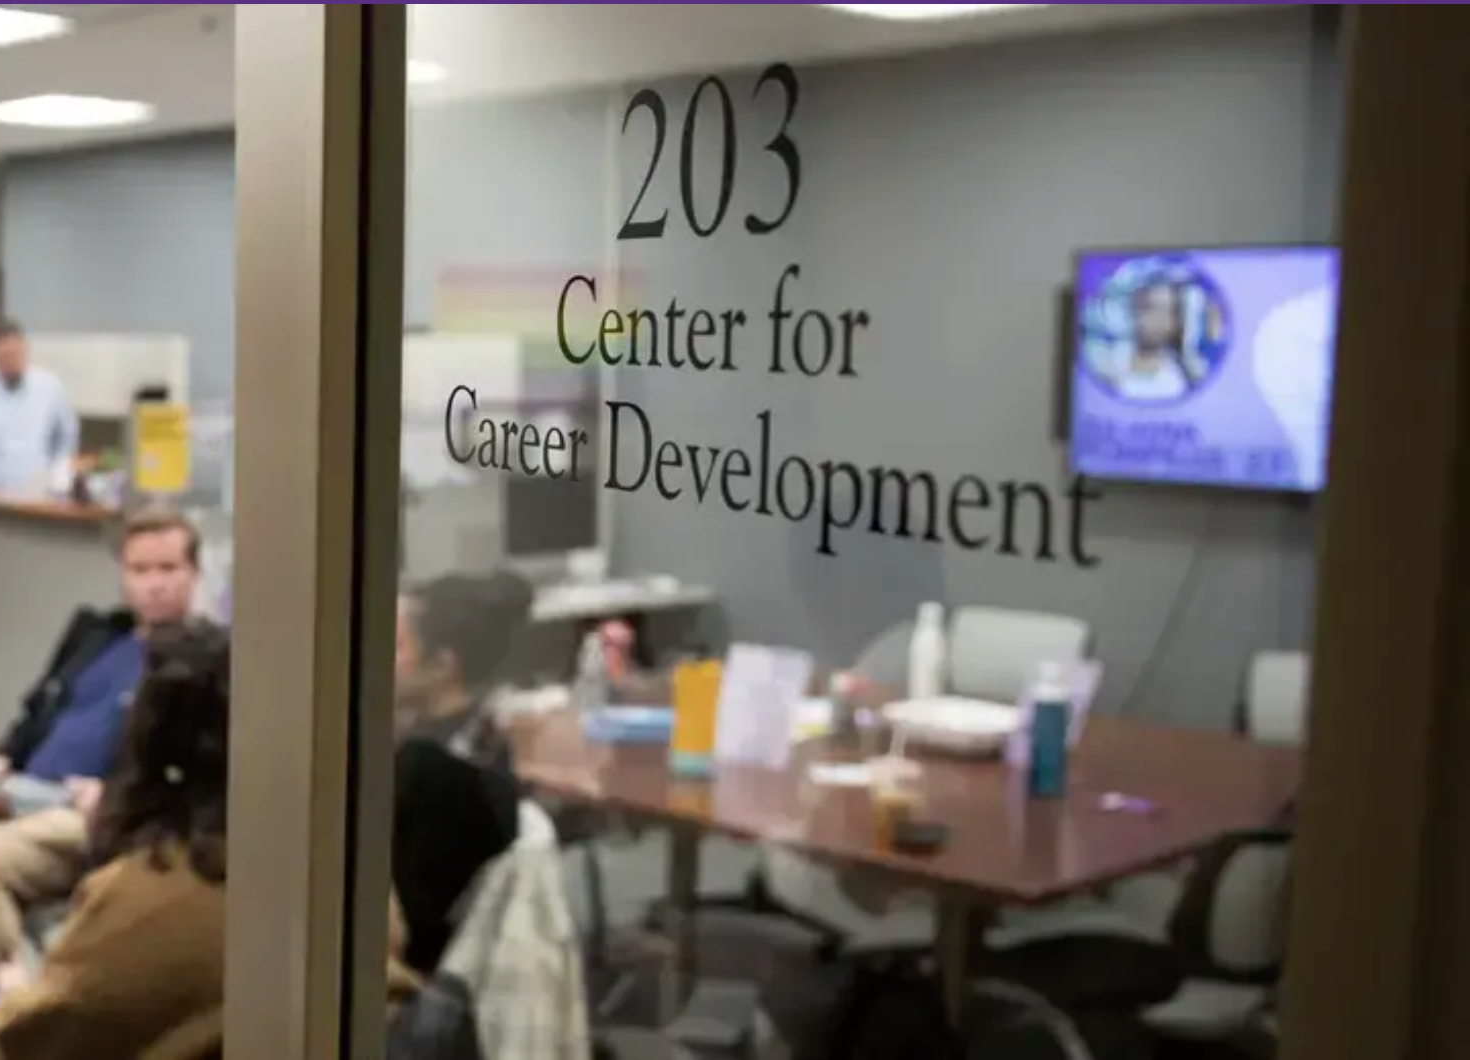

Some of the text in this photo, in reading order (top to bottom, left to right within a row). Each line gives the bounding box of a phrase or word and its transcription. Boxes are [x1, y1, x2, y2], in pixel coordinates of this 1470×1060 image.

[617, 62, 803, 241] 203
[556, 264, 871, 378] Center for
[444, 385, 1104, 568] Career Development
